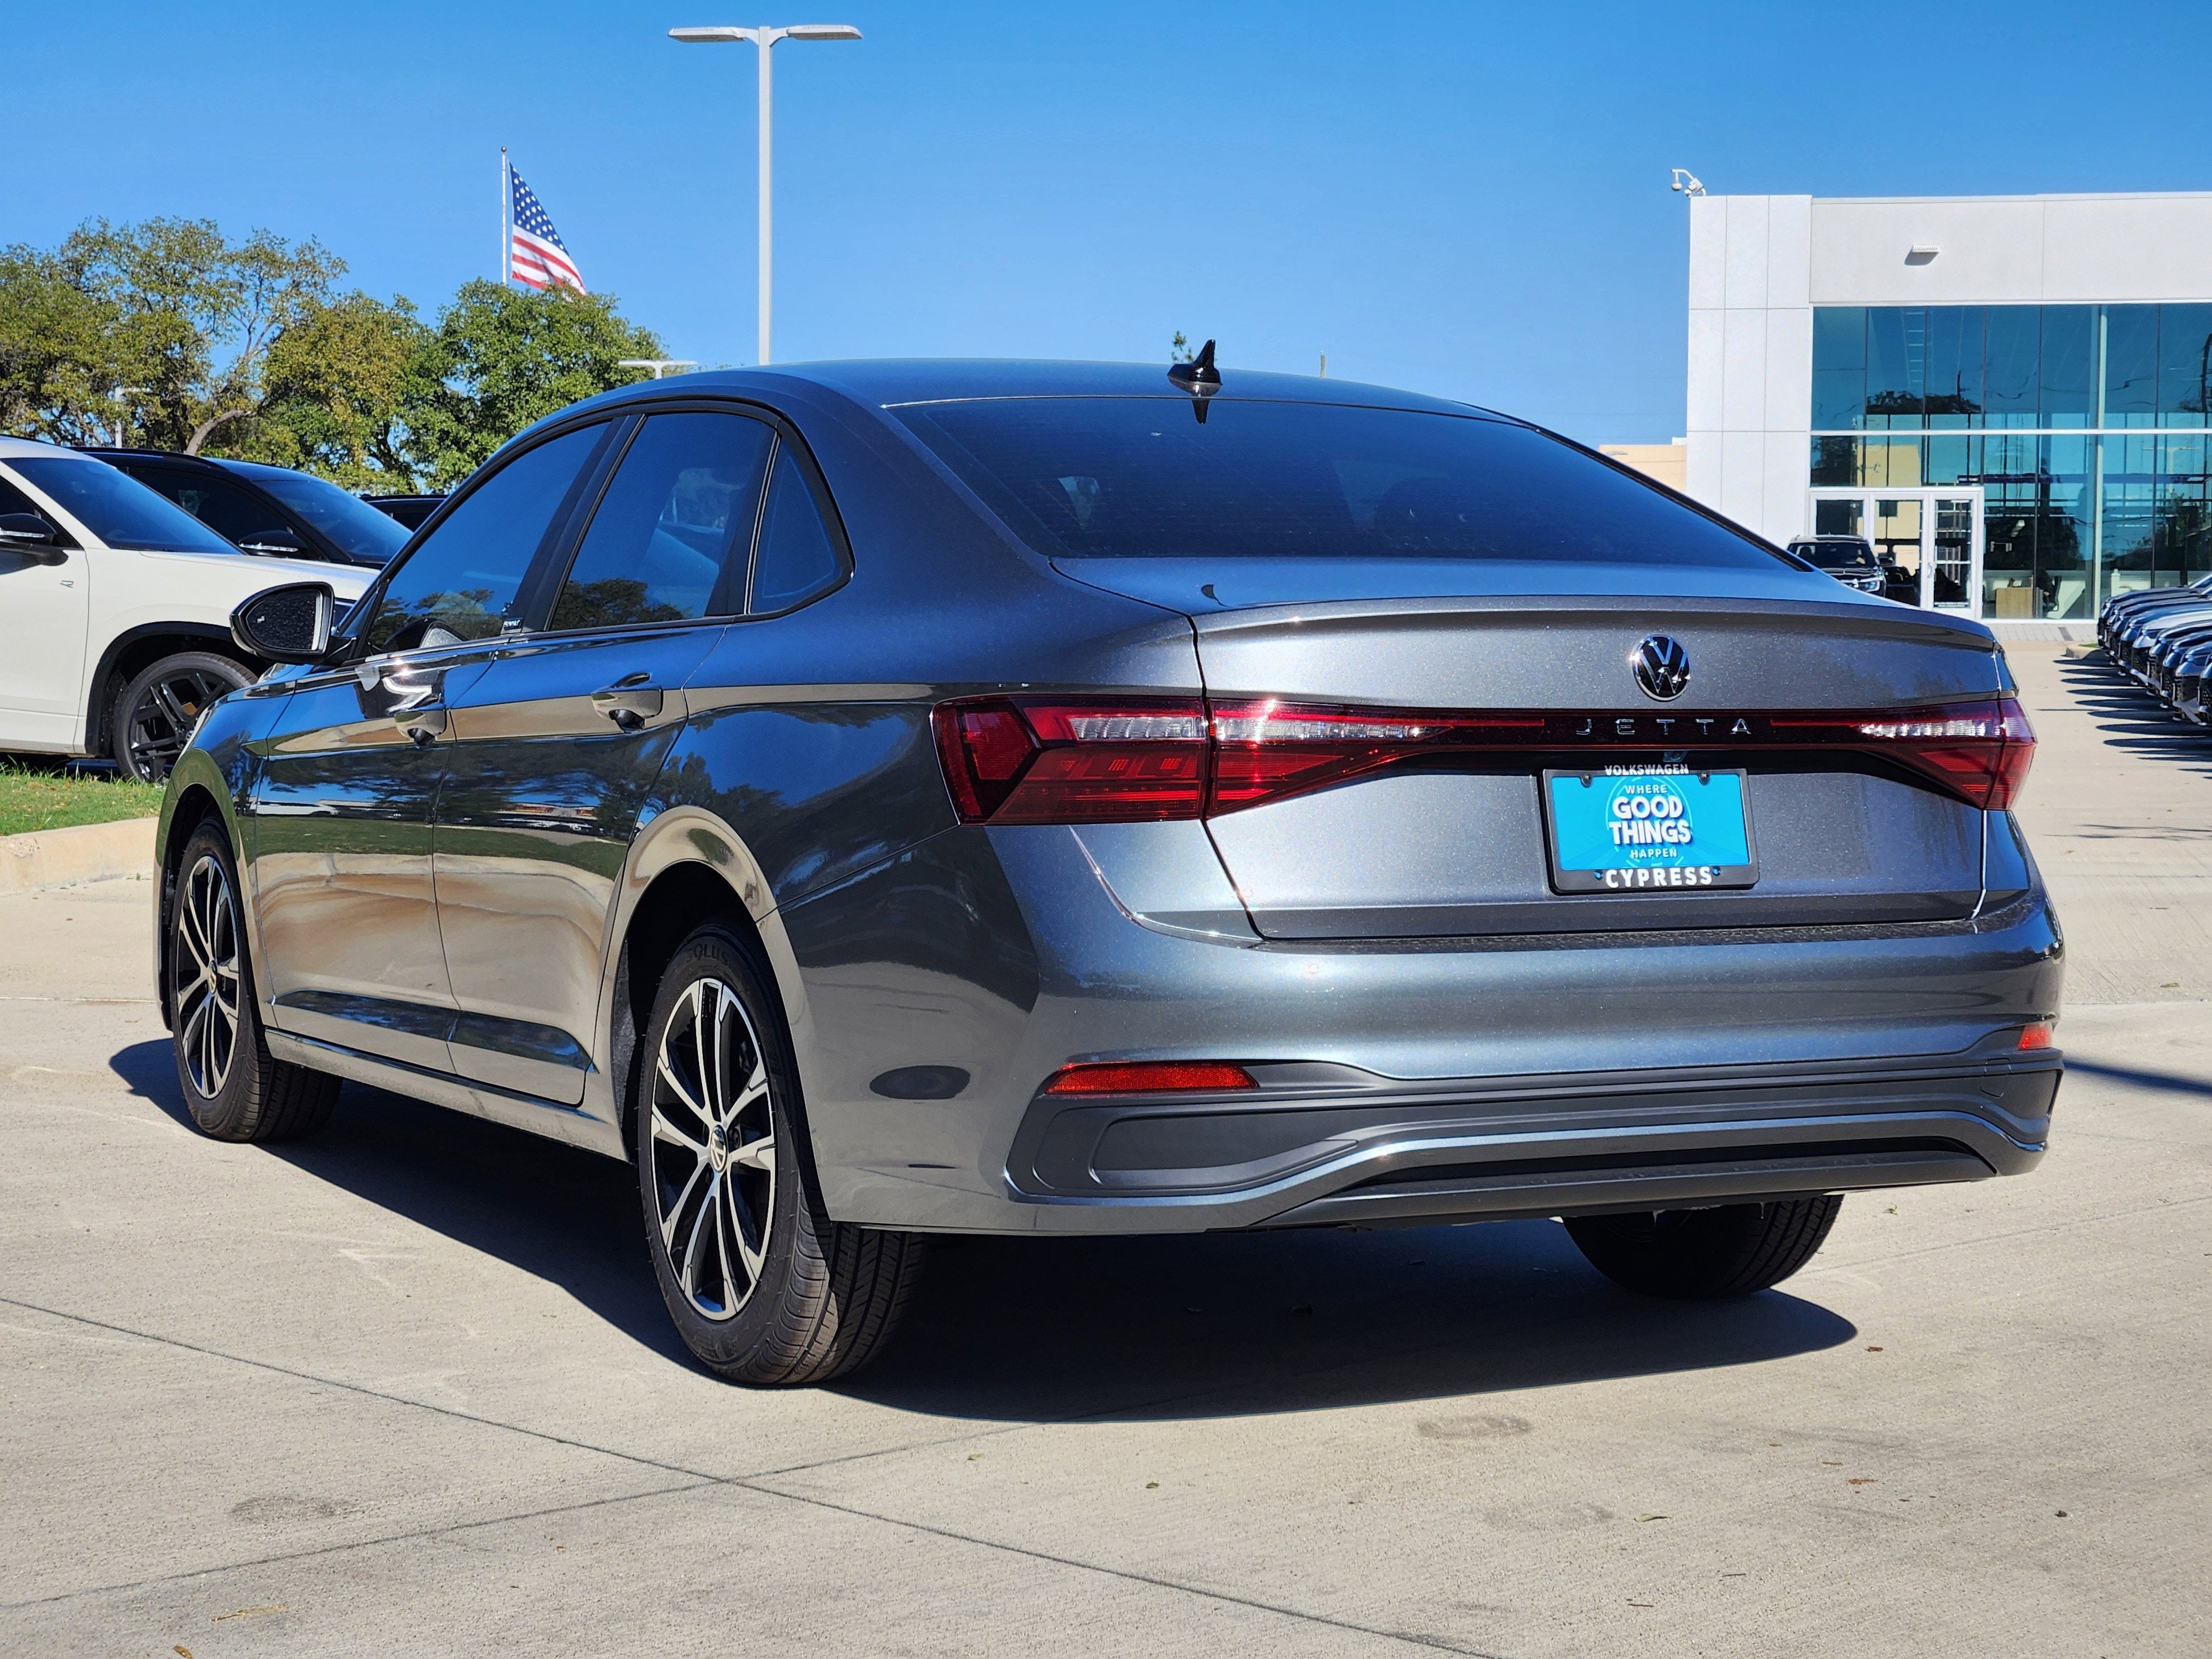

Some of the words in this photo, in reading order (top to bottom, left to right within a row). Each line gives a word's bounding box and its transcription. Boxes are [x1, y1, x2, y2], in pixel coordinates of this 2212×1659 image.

[1576, 719, 1751, 735] JETTA
[1604, 764, 1689, 776] VOLKSWAGEN
[1625, 784, 1667, 794] WHERE
[1613, 795, 1684, 819] GOOD
[1609, 819, 1692, 844] THINGS
[1630, 848, 1678, 858] HAPPEN
[1605, 867, 1713, 888] CYPRESS
